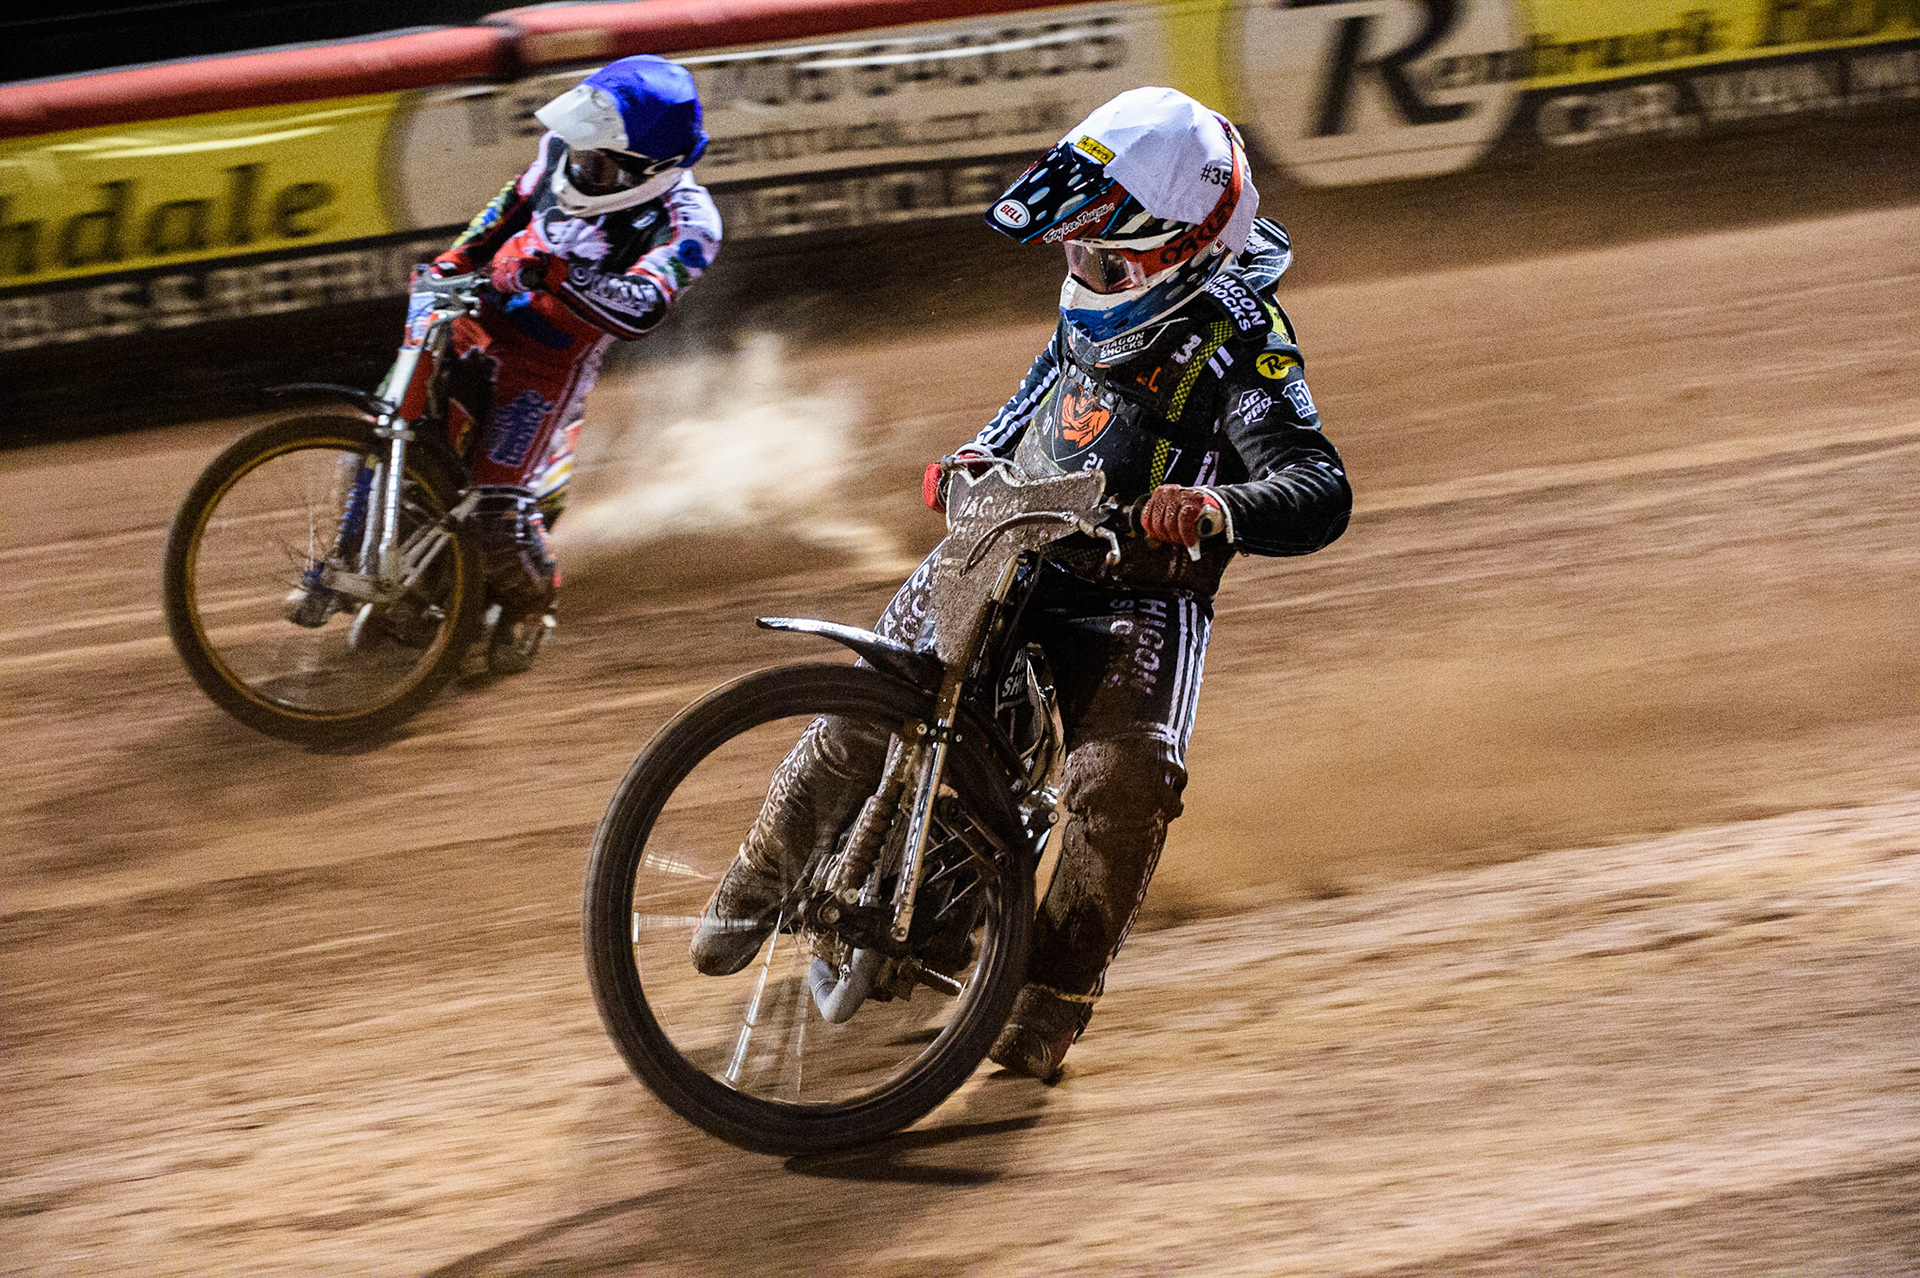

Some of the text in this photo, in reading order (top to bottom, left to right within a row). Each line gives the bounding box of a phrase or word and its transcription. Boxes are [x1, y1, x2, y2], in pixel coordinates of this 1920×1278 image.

[1200, 164, 1232, 188] #35
[1000, 204, 1024, 223] BELL
[1043, 228, 1064, 244] Troy
[1062, 219, 1079, 236] Lee
[1212, 273, 1266, 326] HAGON
[1100, 340, 1145, 359] SHOCKS
[1102, 332, 1146, 351] HAGON
